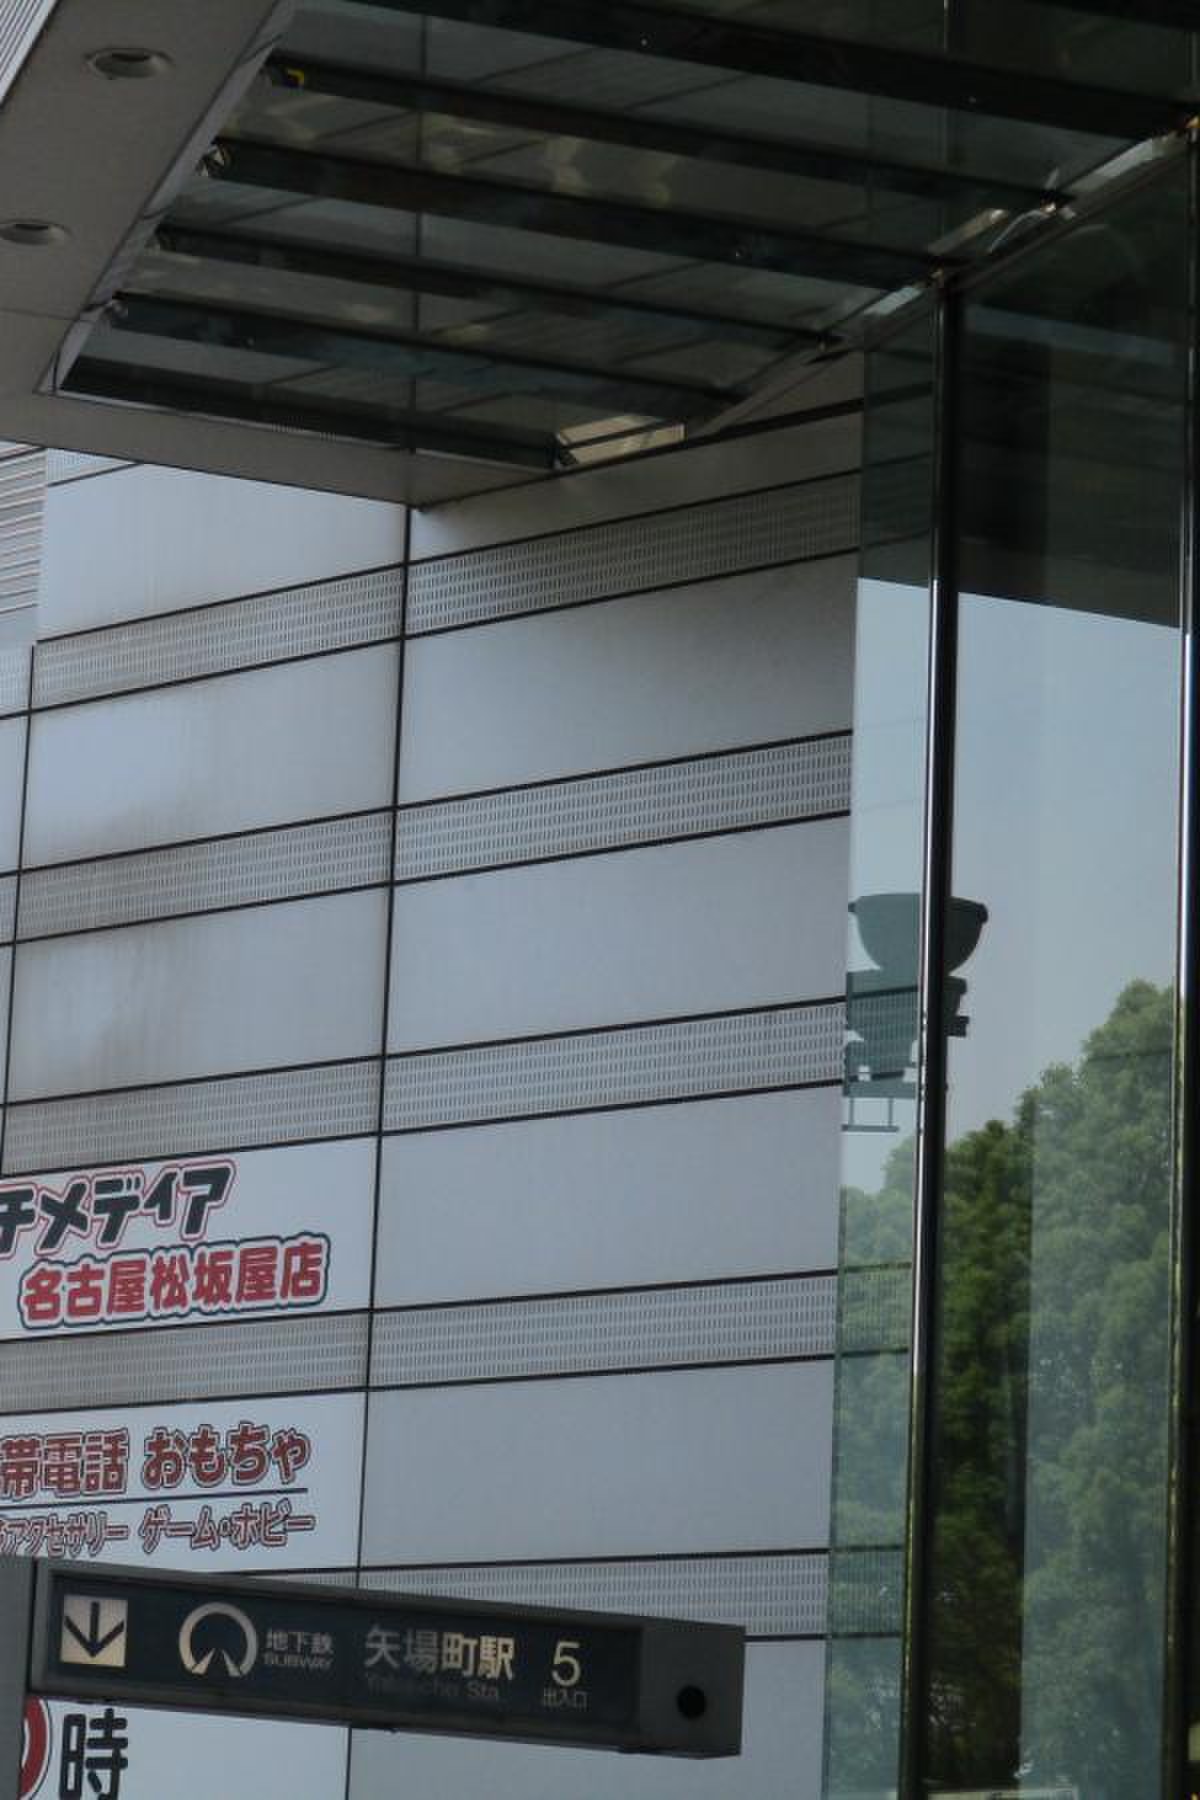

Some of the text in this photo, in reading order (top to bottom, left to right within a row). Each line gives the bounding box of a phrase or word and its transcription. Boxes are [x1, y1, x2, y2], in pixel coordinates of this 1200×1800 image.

[17, 1230, 330, 1331] 名古屋松坂屋店
[265, 1629, 334, 1655] 地下鉄
[363, 1623, 582, 1688] 矢場町駅 5
